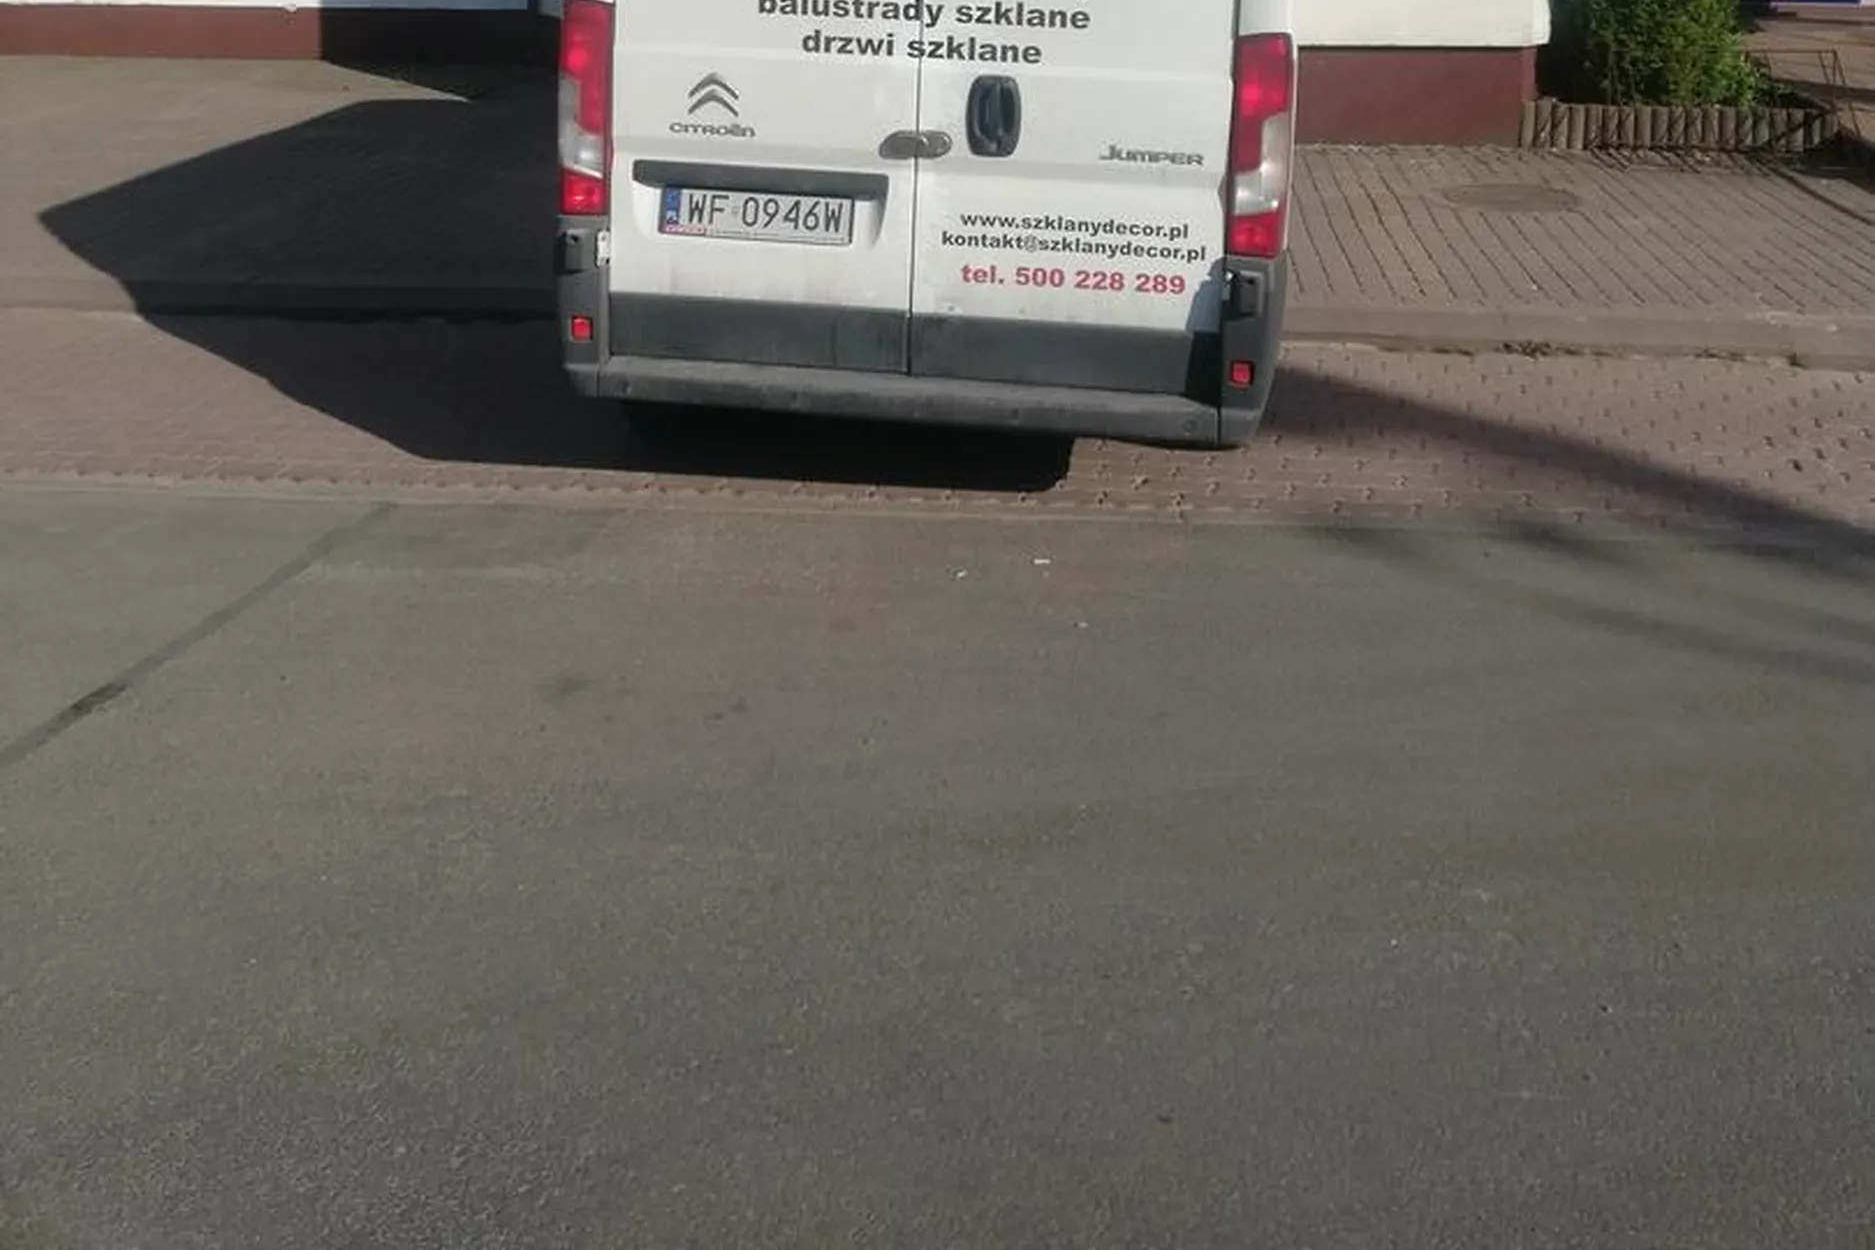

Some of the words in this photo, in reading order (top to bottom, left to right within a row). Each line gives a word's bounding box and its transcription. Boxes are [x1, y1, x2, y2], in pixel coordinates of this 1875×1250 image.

[955, 1, 1091, 30] szklane
[802, 29, 895, 57] drzwi
[907, 35, 1043, 64] szklane
[688, 193, 730, 224] WF
[741, 196, 844, 233] 0946W
[960, 213, 1190, 241] www.szklanydecor.pl
[941, 230, 1207, 262] kontakt@szklanydecor.pl
[961, 264, 1004, 285] tel.
[1015, 267, 1066, 288] 500
[1074, 270, 1126, 291] 228
[1135, 274, 1187, 295] 289
